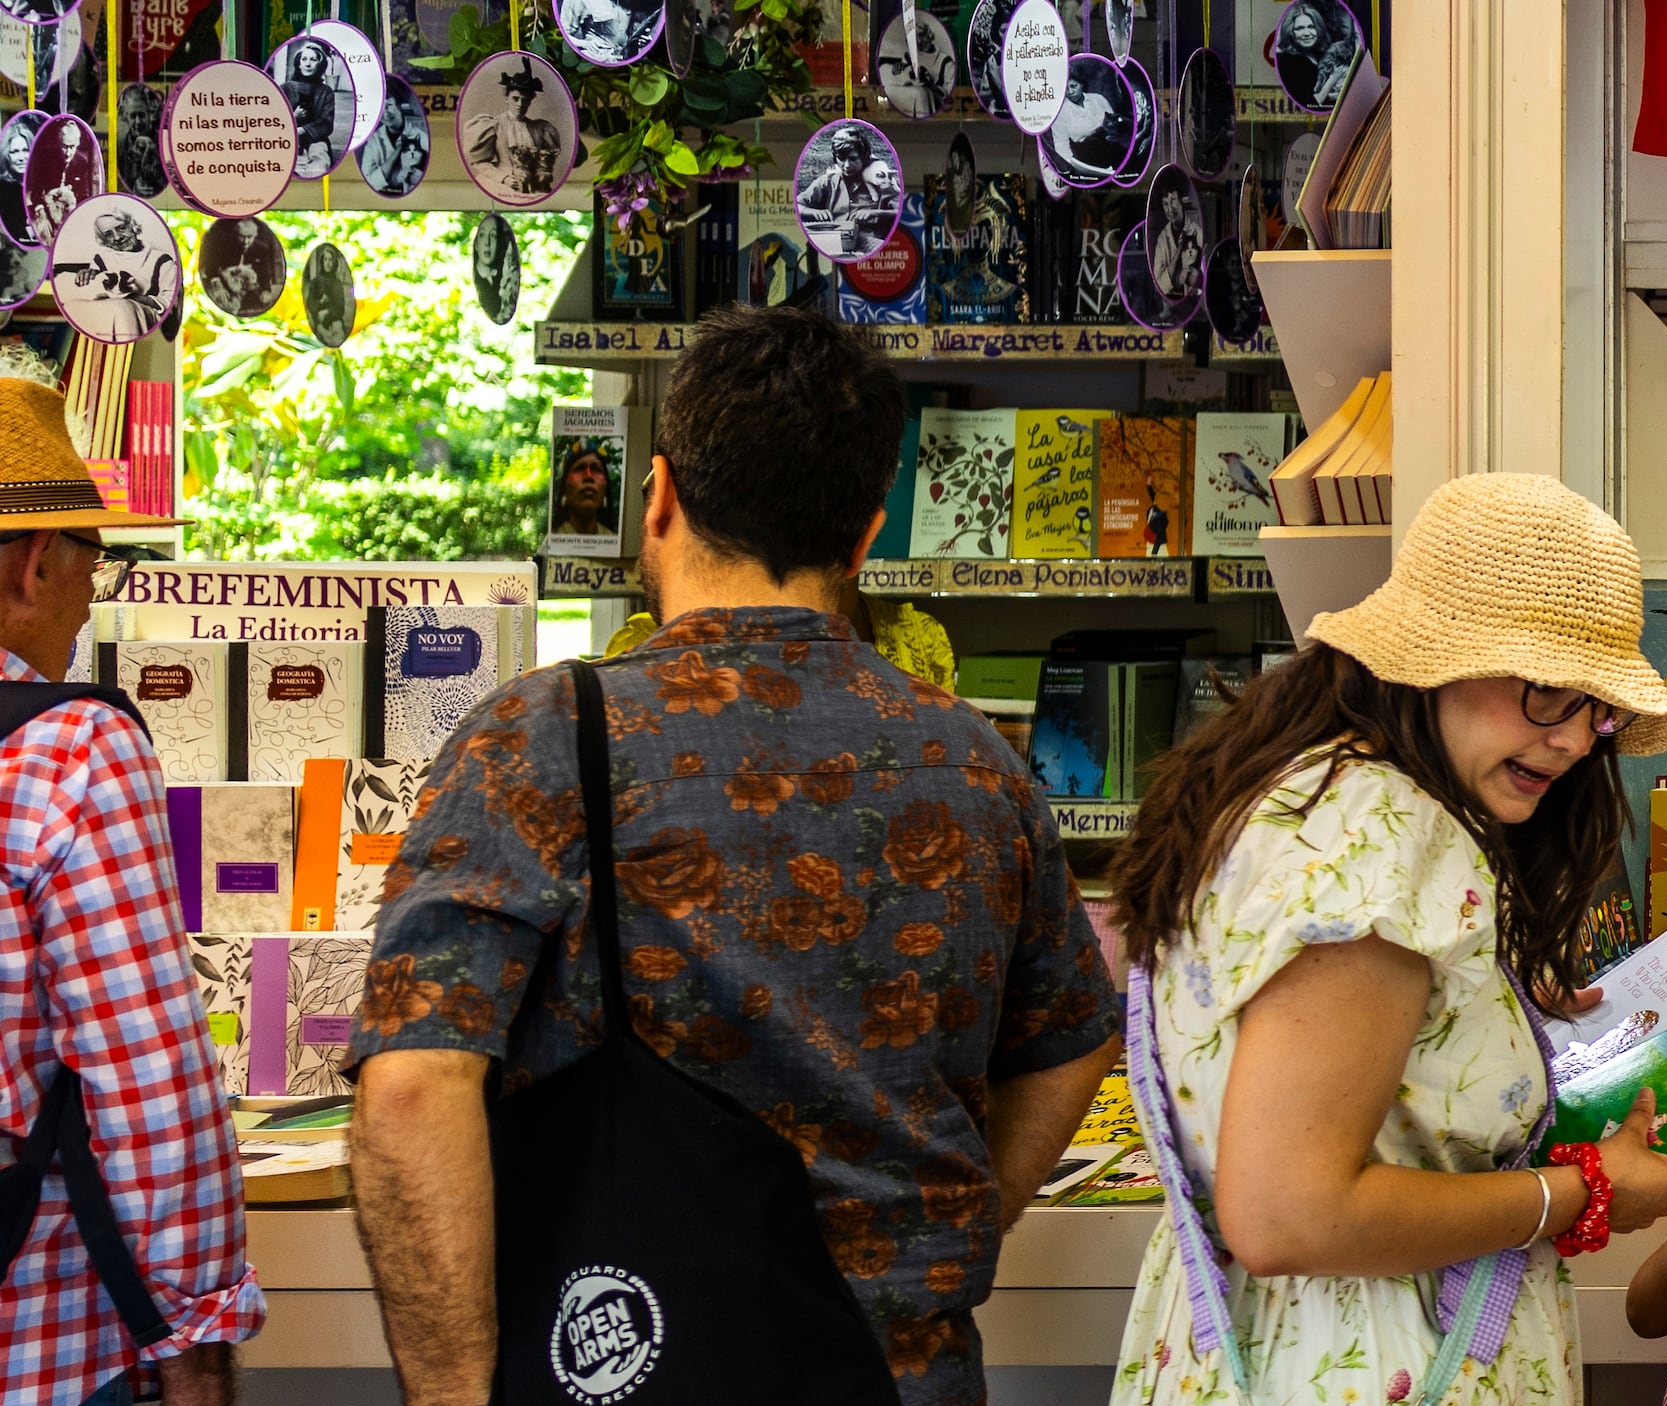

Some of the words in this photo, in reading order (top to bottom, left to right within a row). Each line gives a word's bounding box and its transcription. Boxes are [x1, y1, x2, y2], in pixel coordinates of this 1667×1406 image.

[191, 92, 208, 106] Ni
[211, 92, 224, 106] la
[229, 91, 270, 106] tierra
[179, 116, 193, 129] ni
[196, 116, 218, 129] las
[223, 115, 285, 133] mujeres,
[177, 140, 224, 153] somos
[228, 138, 291, 152] territorio
[187, 160, 204, 175] de
[208, 159, 284, 181] conquista.
[544, 327, 641, 350] Isabel
[932, 329, 1063, 357] Margaret
[1073, 328, 1166, 353] Atwood
[564, 408, 614, 418] SEREMOS
[1028, 423, 1053, 449] La
[1028, 451, 1068, 470] casa
[1071, 431, 1093, 458] de
[1025, 488, 1089, 522] pájaros
[553, 562, 626, 585] Maya
[858, 562, 934, 588] rontë
[952, 561, 1023, 588] Elena
[1033, 562, 1187, 592] Poniatowska
[191, 615, 227, 641] La
[238, 616, 367, 642] Editorial
[418, 633, 437, 645] NO
[438, 633, 465, 645] VOY
[1634, 966, 1651, 983] Who
[1647, 956, 1665, 973] The
[1627, 983, 1645, 1000] Tea
[567, 1297, 632, 1346] OPEN
[574, 1322, 639, 1371] ARMS
[567, 1384, 593, 1406] SEA
[601, 1349, 661, 1406] RESCUE
